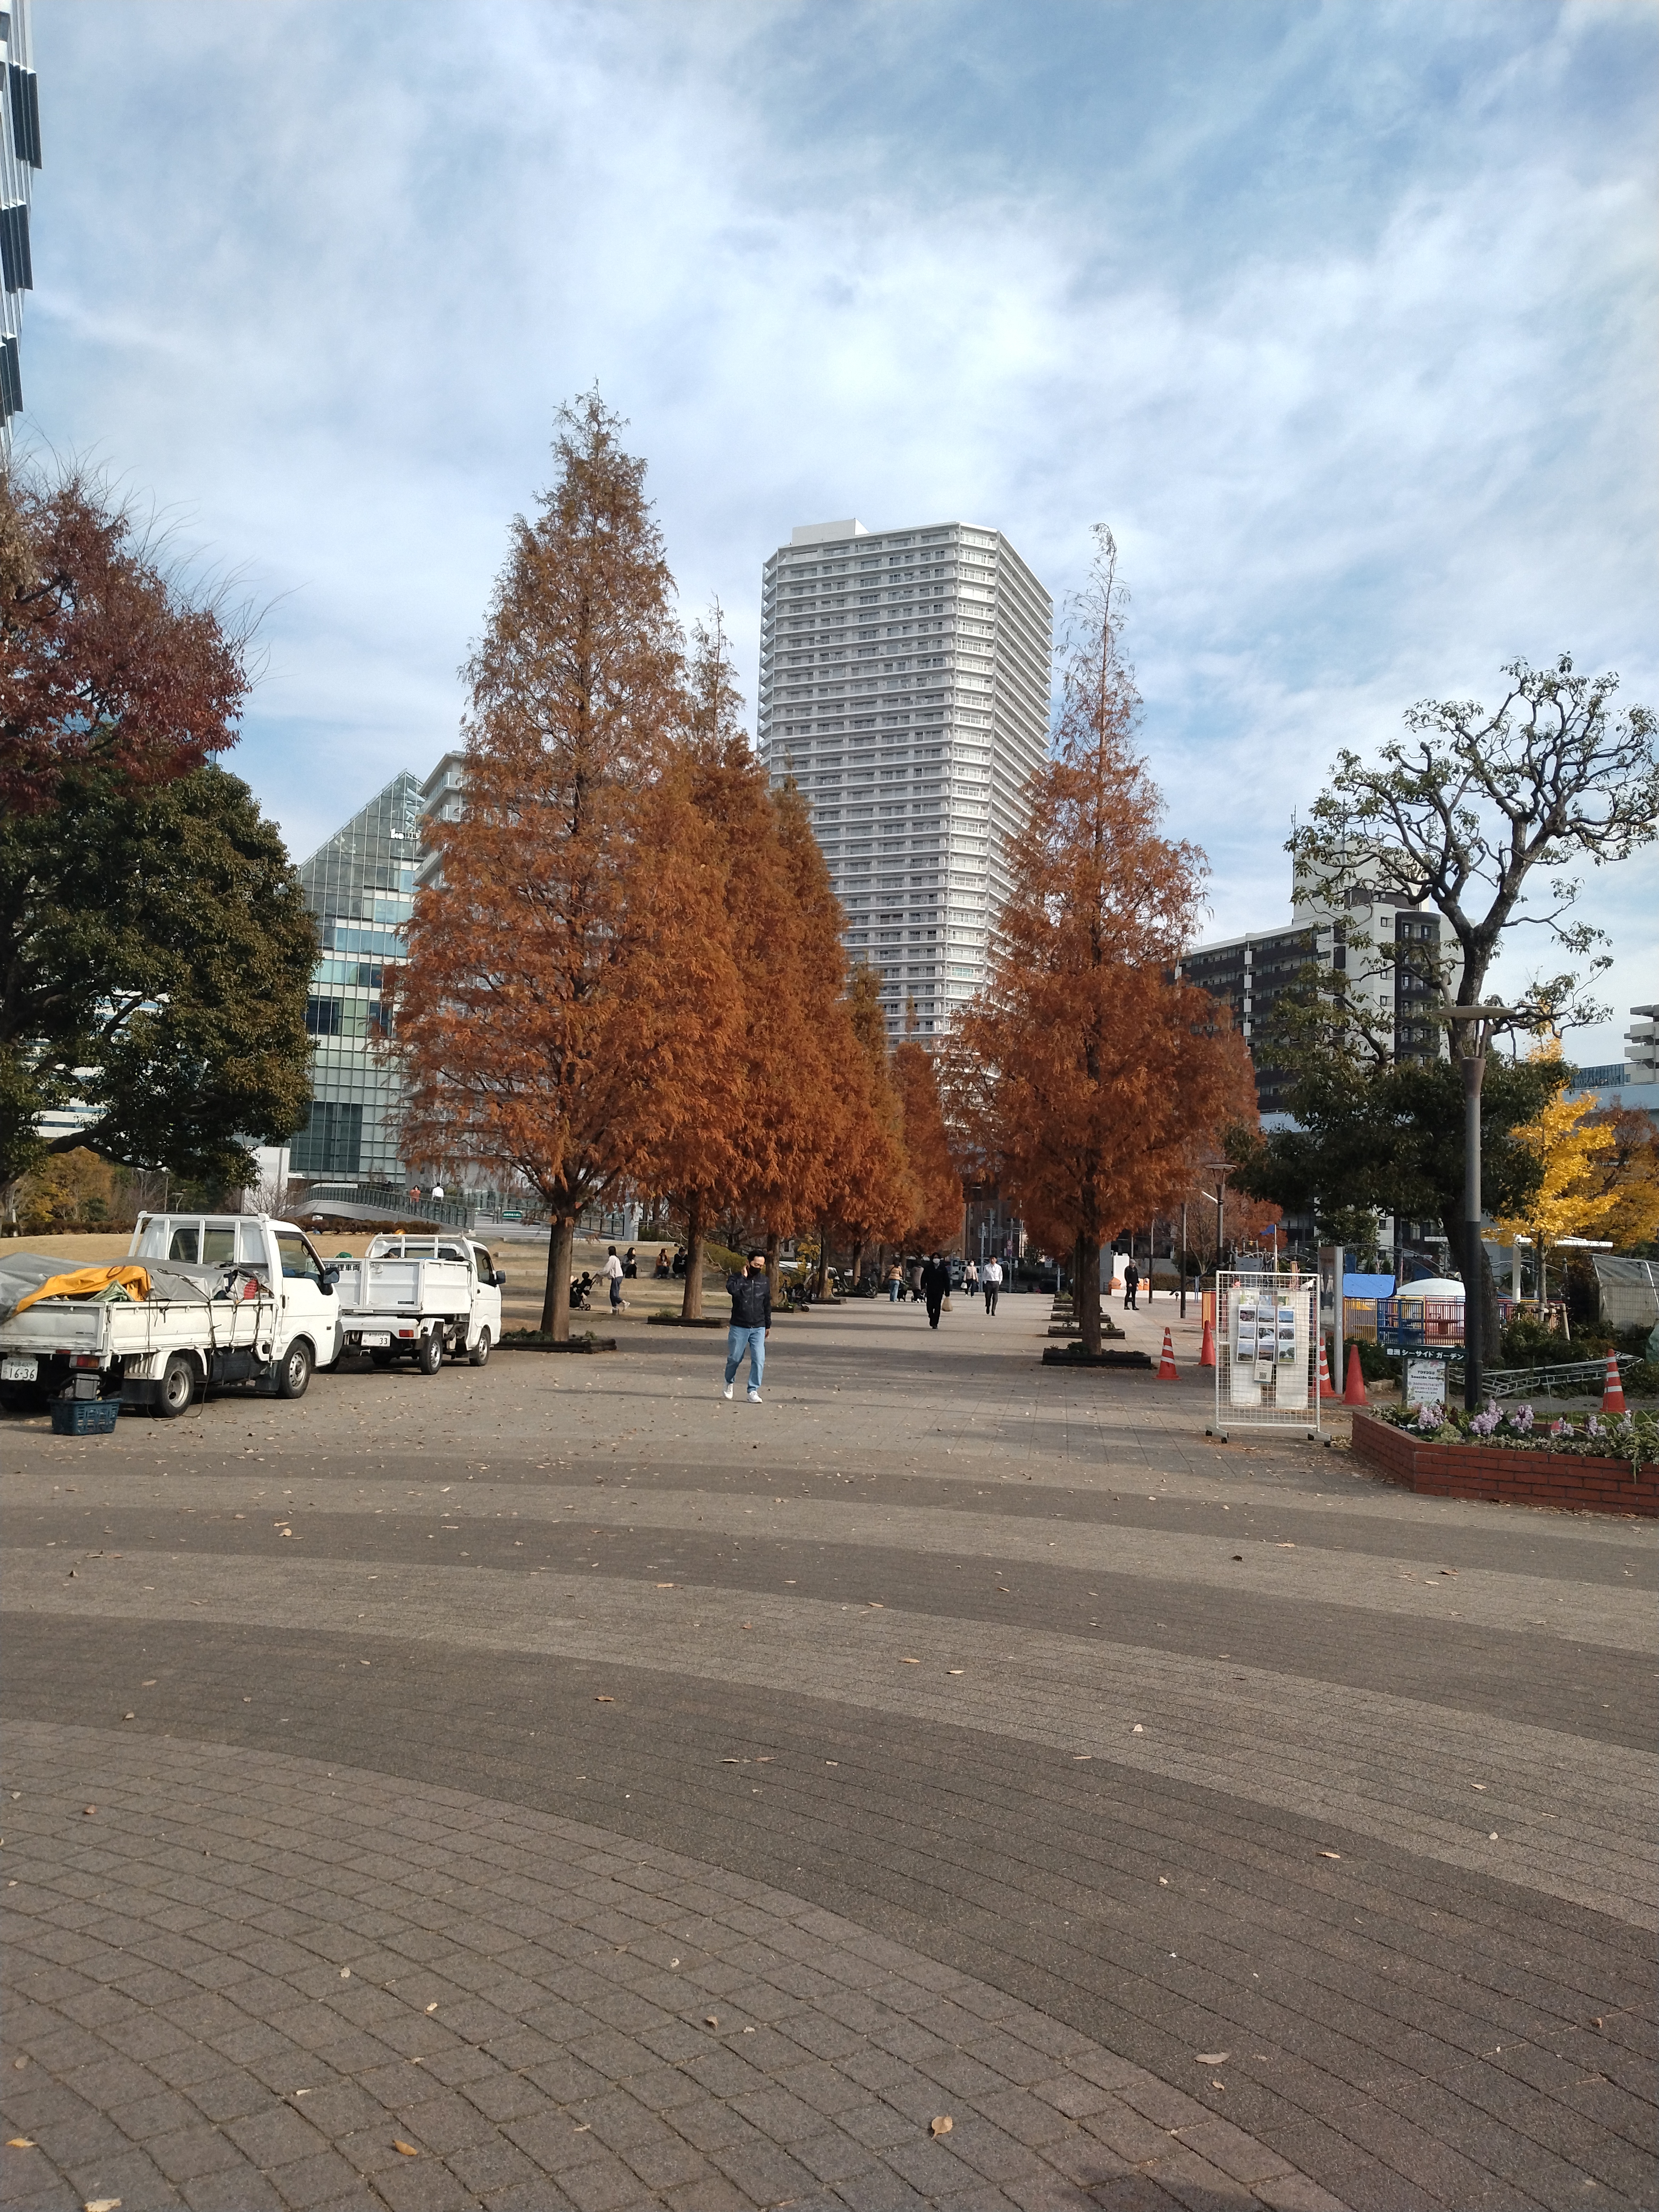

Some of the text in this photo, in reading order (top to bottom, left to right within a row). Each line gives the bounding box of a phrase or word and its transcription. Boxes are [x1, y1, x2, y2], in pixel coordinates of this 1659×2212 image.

[1402, 1349, 1435, 1358] シーサイド
[1436, 1352, 1464, 1360] ガーデン
[10, 1368, 35, 1379] 16-36
